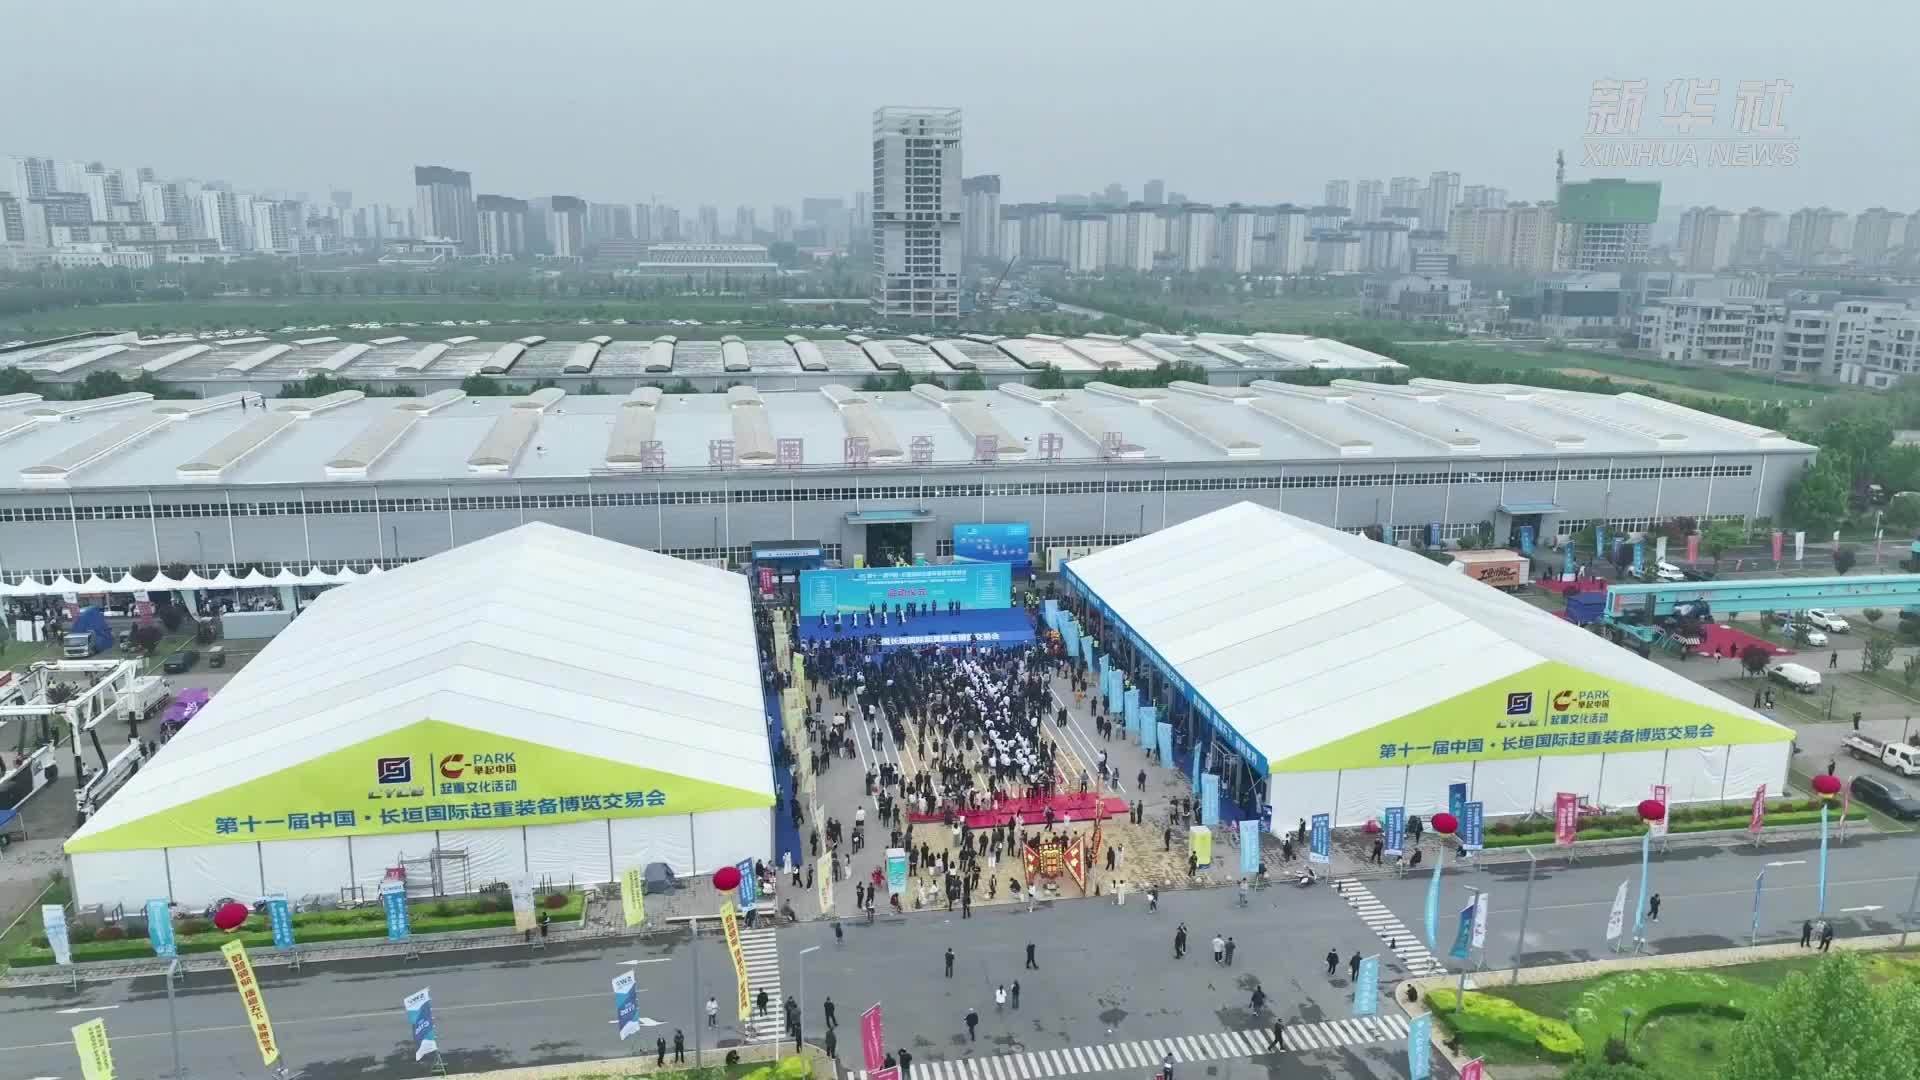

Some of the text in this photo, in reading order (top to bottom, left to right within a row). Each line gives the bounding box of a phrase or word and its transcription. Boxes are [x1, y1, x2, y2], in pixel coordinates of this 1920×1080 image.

[1551, 712, 1609, 725] 起重文化活动
[439, 779, 517, 795] 起重文化活动
